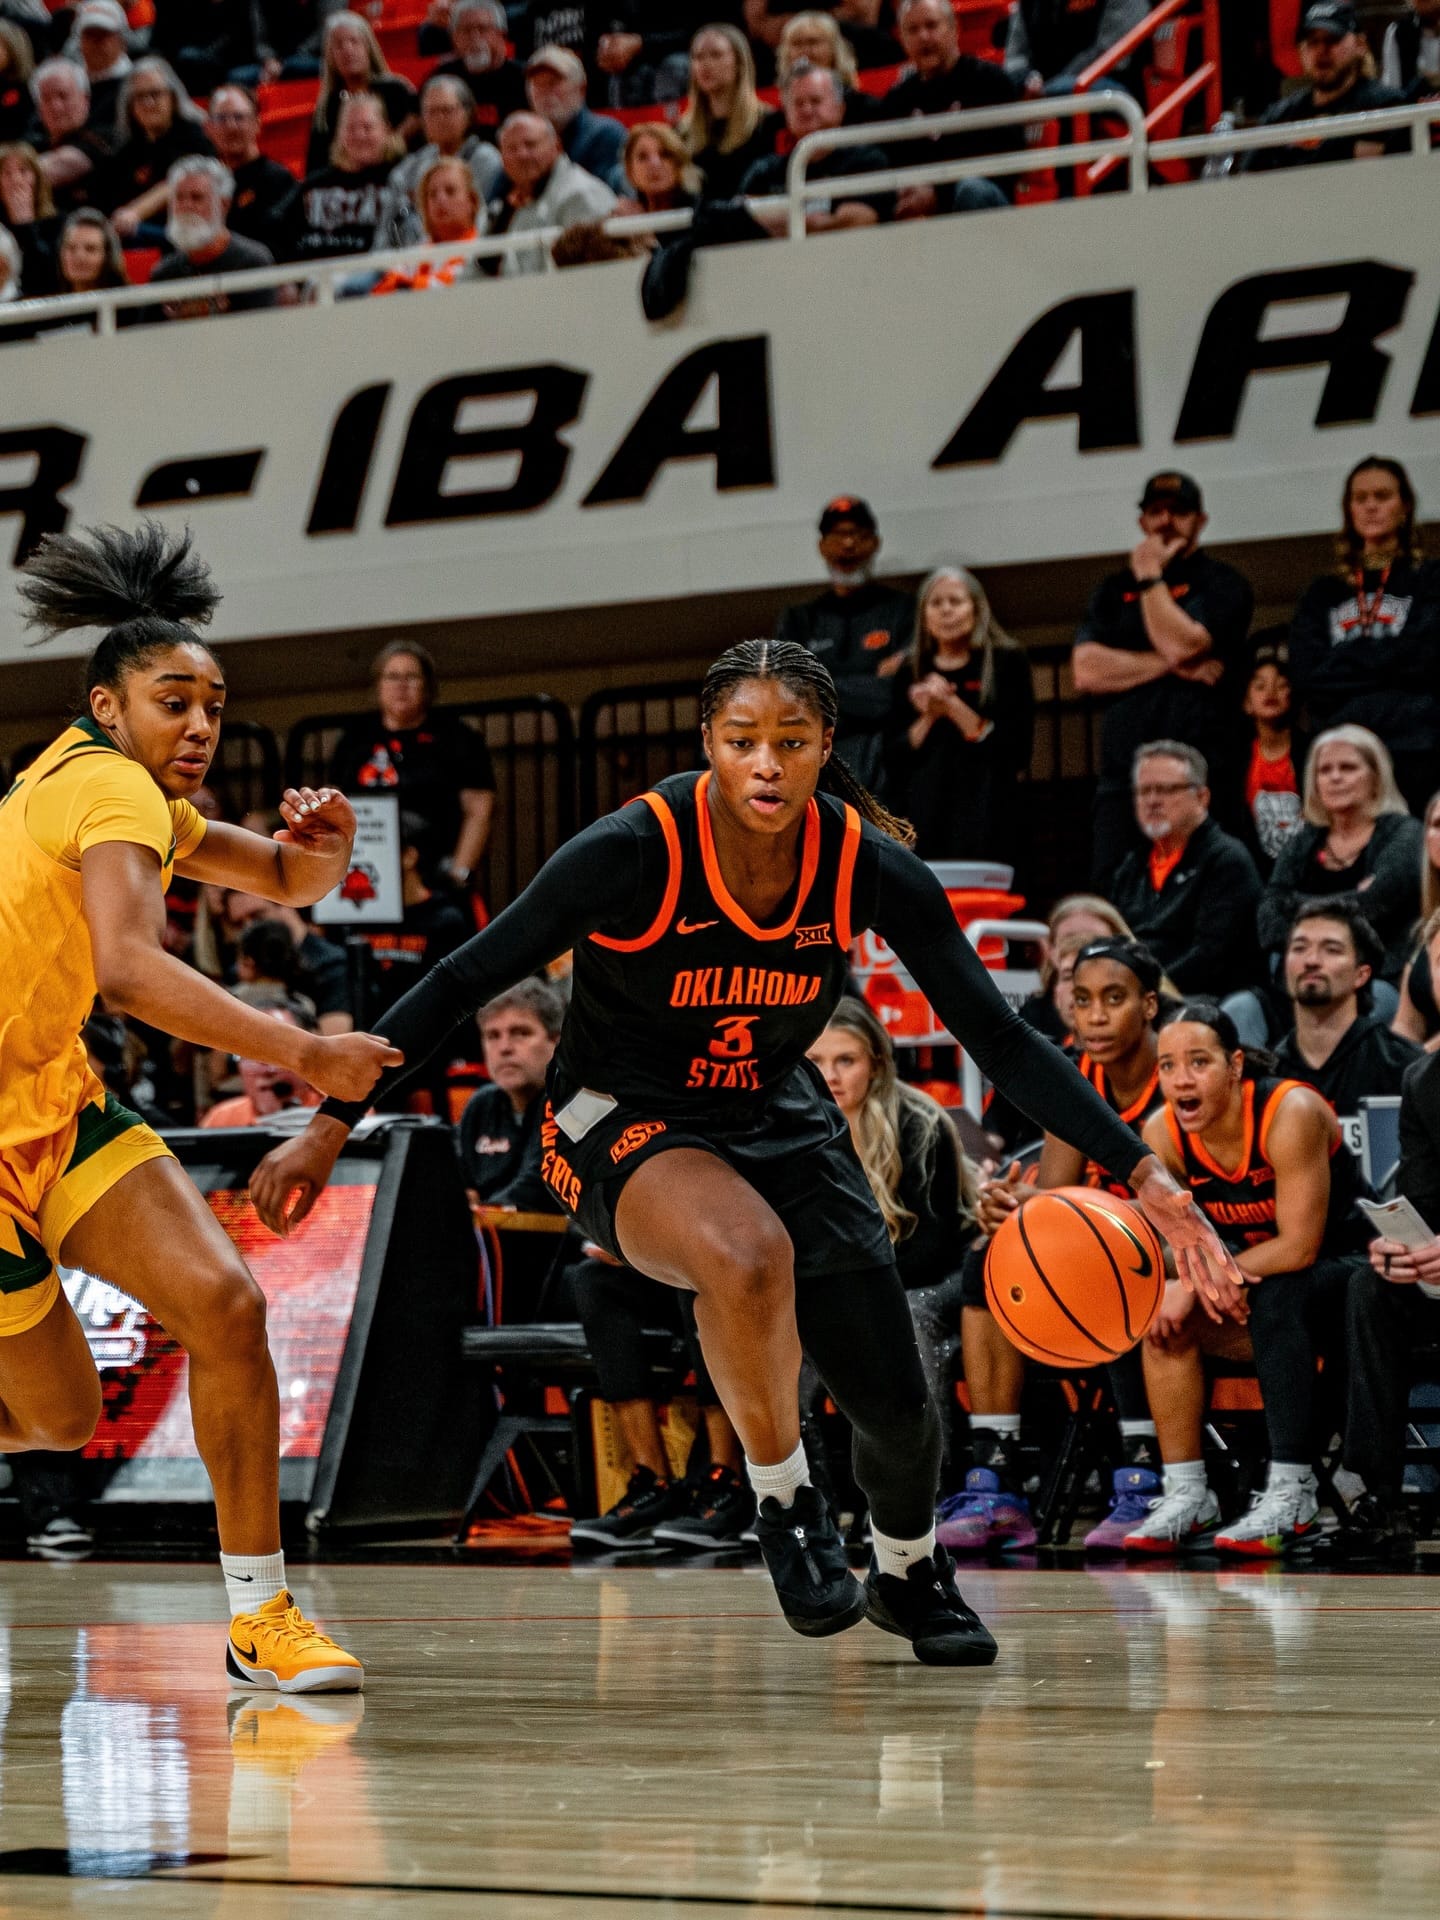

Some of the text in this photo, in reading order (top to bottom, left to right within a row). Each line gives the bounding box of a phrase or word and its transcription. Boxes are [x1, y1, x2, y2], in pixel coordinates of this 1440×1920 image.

[931, 259, 1440, 470] AR
[798, 927, 829, 946] XII
[670, 966, 822, 1008] OKLAHOMA
[708, 1015, 760, 1057] 3
[685, 1058, 764, 1091] STATE
